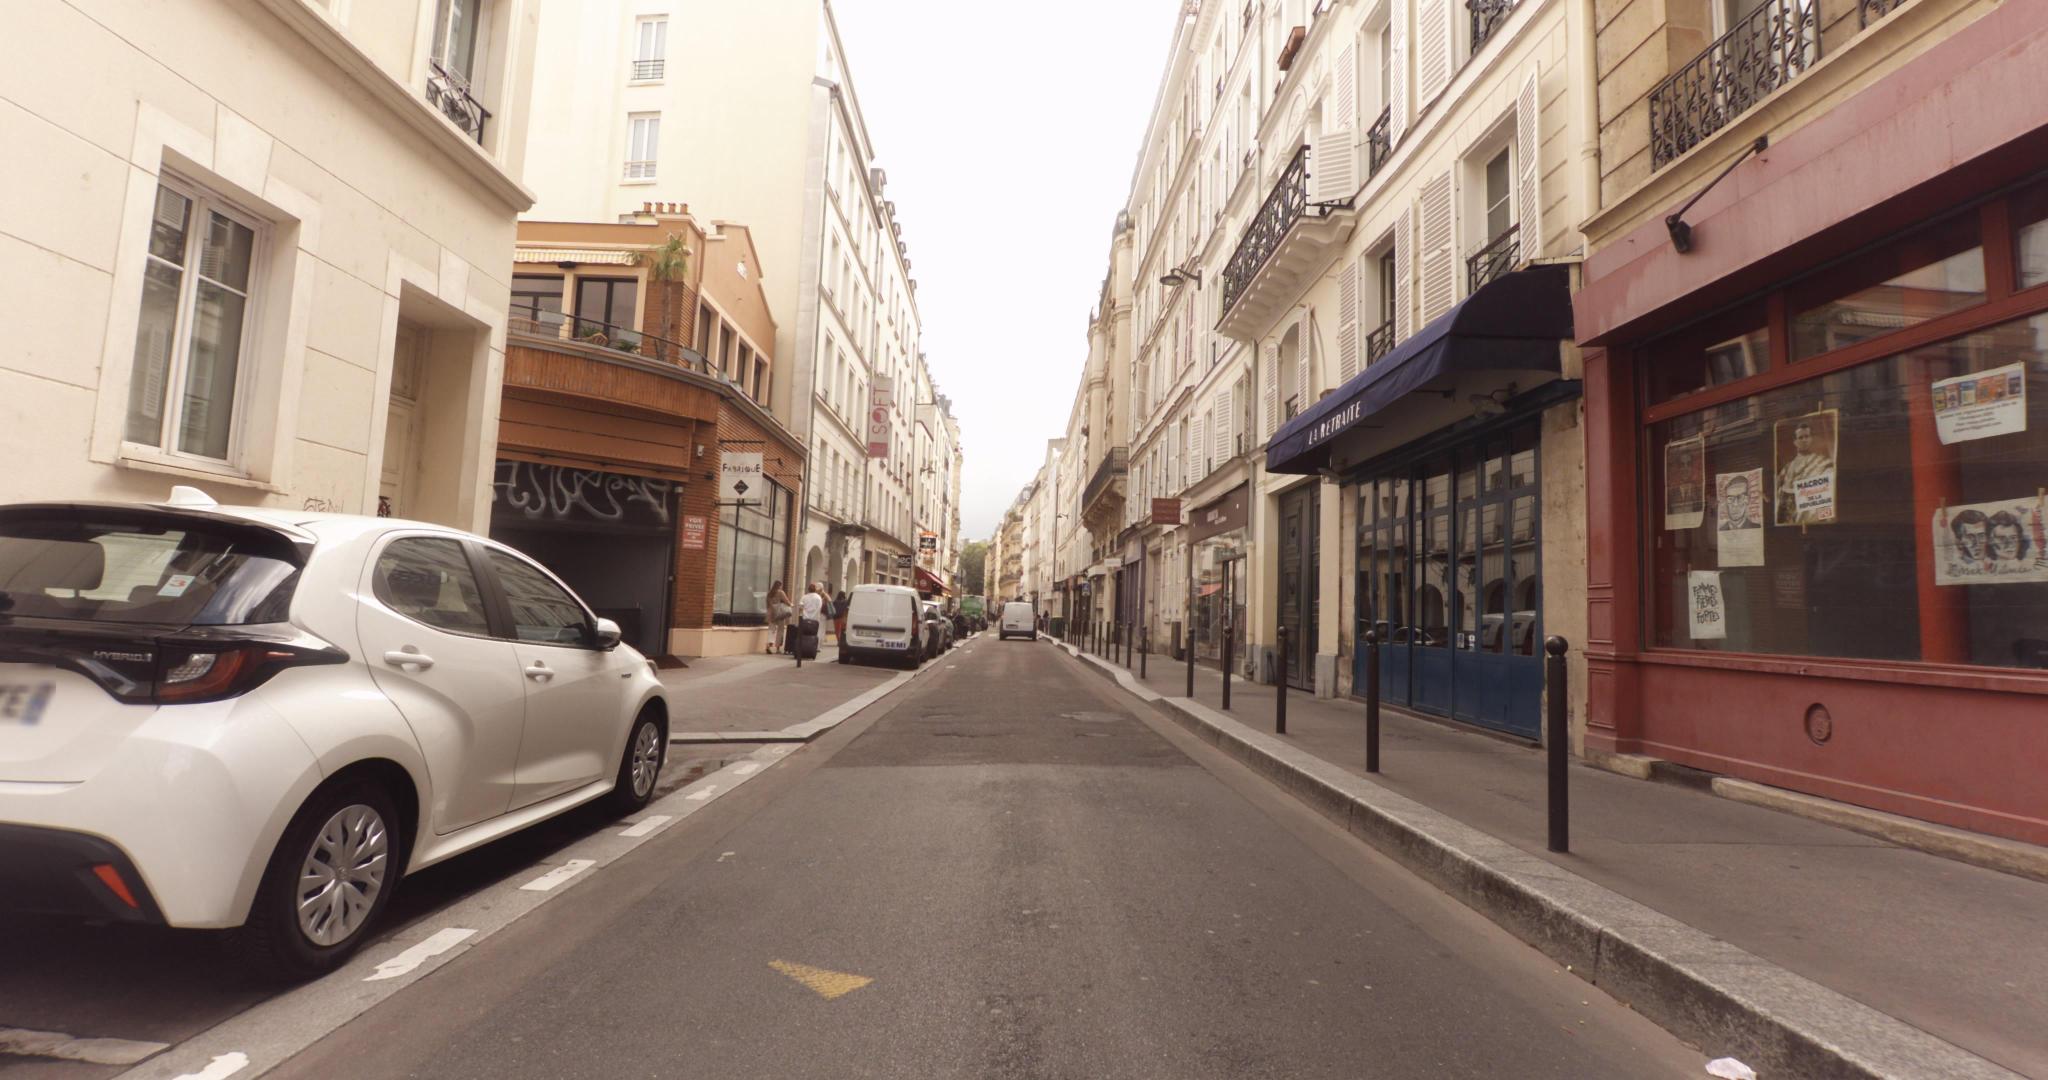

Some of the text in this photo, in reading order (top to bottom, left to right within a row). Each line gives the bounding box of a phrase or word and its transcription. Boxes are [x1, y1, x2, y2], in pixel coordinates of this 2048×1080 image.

[871, 386, 890, 434] SOFT
[1308, 400, 1361, 445] LA RETRAITE
[722, 463, 761, 473] FABRIQUE
[1796, 476, 1830, 491] MACRON
